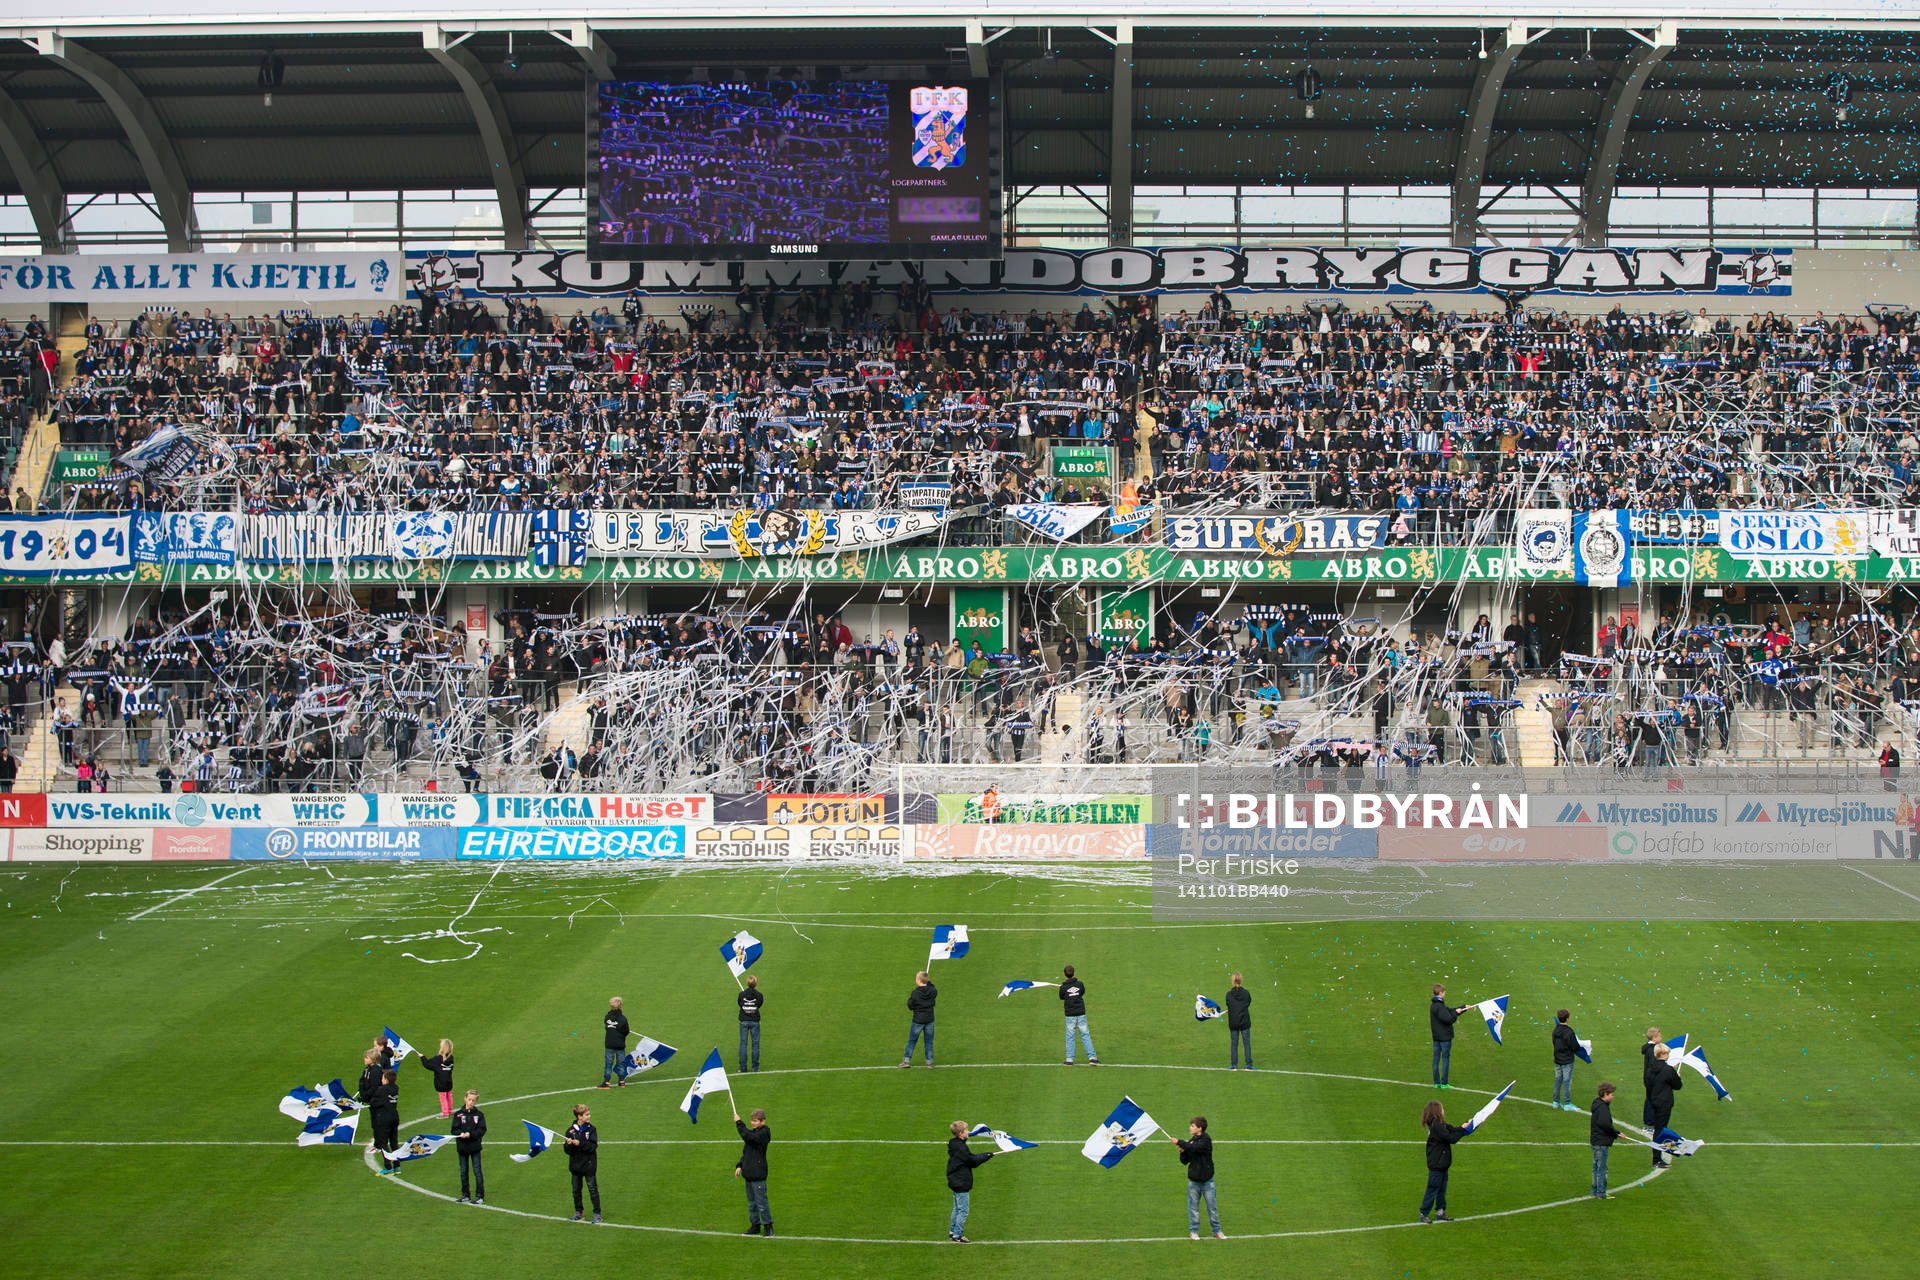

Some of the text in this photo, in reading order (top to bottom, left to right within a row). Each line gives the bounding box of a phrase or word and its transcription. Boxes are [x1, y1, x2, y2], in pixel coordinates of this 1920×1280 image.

[769, 244, 819, 254] SAMSUNG
[90, 263, 198, 290] ALLT
[210, 263, 357, 290] KJETIL
[62, 466, 97, 478] ÅBRO
[1058, 462, 1094, 473] ÅBRO
[902, 488, 935, 499] SYMPATI
[1015, 505, 1065, 538] Klas
[1730, 514, 1822, 529] SEKTION
[1730, 529, 1825, 551] OSLO
[195, 550, 231, 561] KAMRATER
[893, 555, 980, 579] ÅBRO
[1037, 555, 1123, 579] ÅBRO
[956, 615, 1001, 628] ÅBRO
[1102, 617, 1146, 630] ÅBRO
[51, 802, 262, 821] VVS-Teknik Vent
[293, 803, 345, 819] WHC
[403, 803, 456, 819] WHC
[496, 796, 706, 819] FRIGGA HuseT
[795, 802, 880, 823] JOTUN
[1597, 802, 1718, 827] Myresjöhus
[1777, 801, 1897, 827] Myresjöhus
[545, 818, 588, 826] VITVAROR
[590, 818, 607, 826] TILL
[45, 834, 144, 855] Shopping
[303, 831, 421, 849] FRONTBILAR
[462, 830, 679, 856] EHRENBORG
[695, 840, 790, 857] EKSJÖHUS
[810, 840, 900, 857] EKSJÖHUS
[973, 825, 1089, 855] Renova
[1180, 827, 1343, 853] Björnkläder
[1642, 830, 1833, 855] bafab kontorsmöbler
